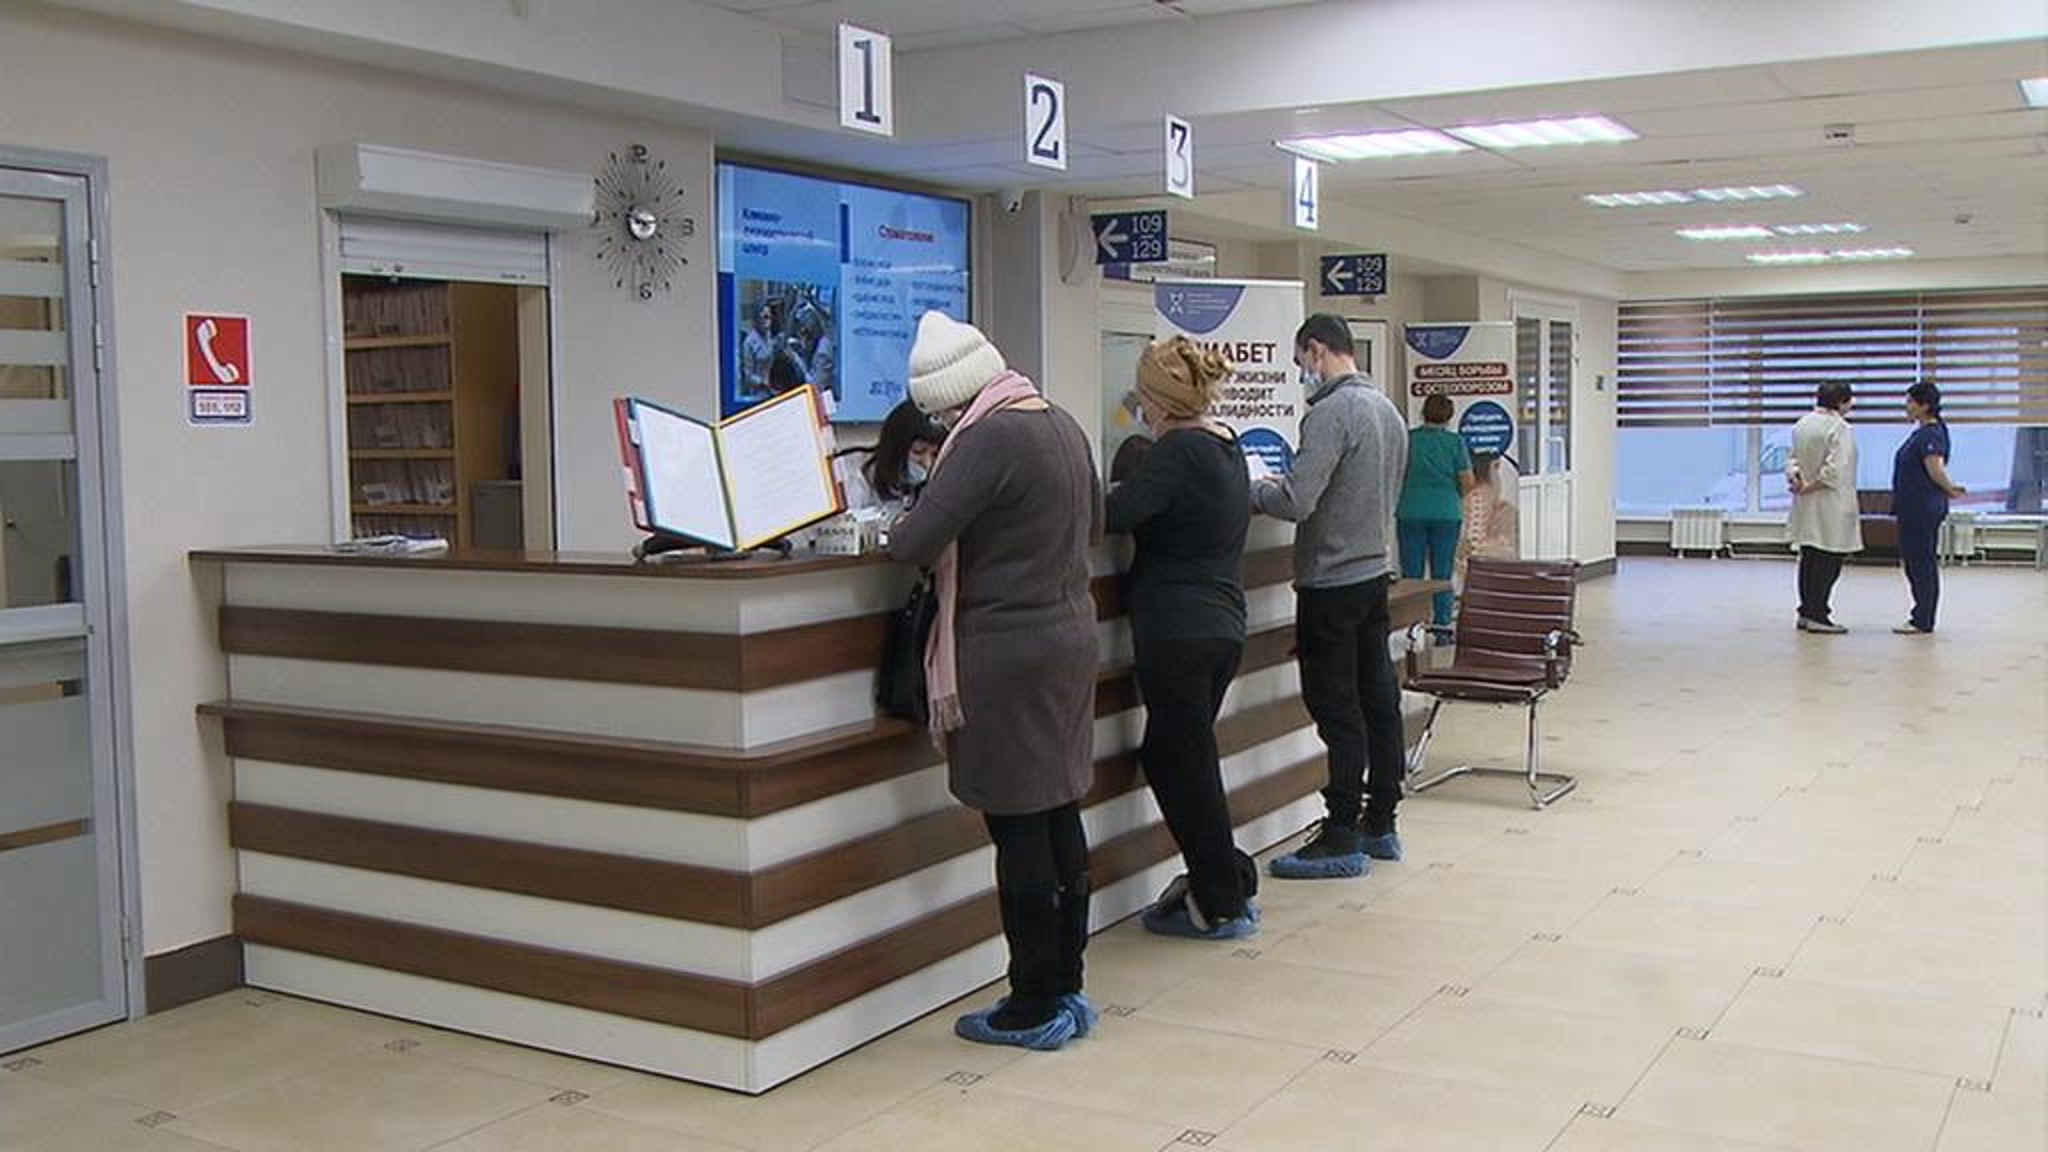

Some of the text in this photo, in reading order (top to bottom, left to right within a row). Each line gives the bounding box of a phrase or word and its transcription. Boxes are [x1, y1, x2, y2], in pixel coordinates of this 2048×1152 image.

[853, 39, 881, 124] 1
[1031, 84, 1059, 161] 2
[1170, 122, 1188, 188] 3
[1299, 166, 1315, 223] 4
[683, 217, 695, 236] 3
[1132, 214, 1163, 234] 109
[1132, 240, 1163, 259] 129
[1357, 257, 1383, 272] 109
[639, 282, 653, 300] 6
[1357, 277, 1383, 292] 129
[1203, 404, 1295, 418] АЛИДНОСТИ
